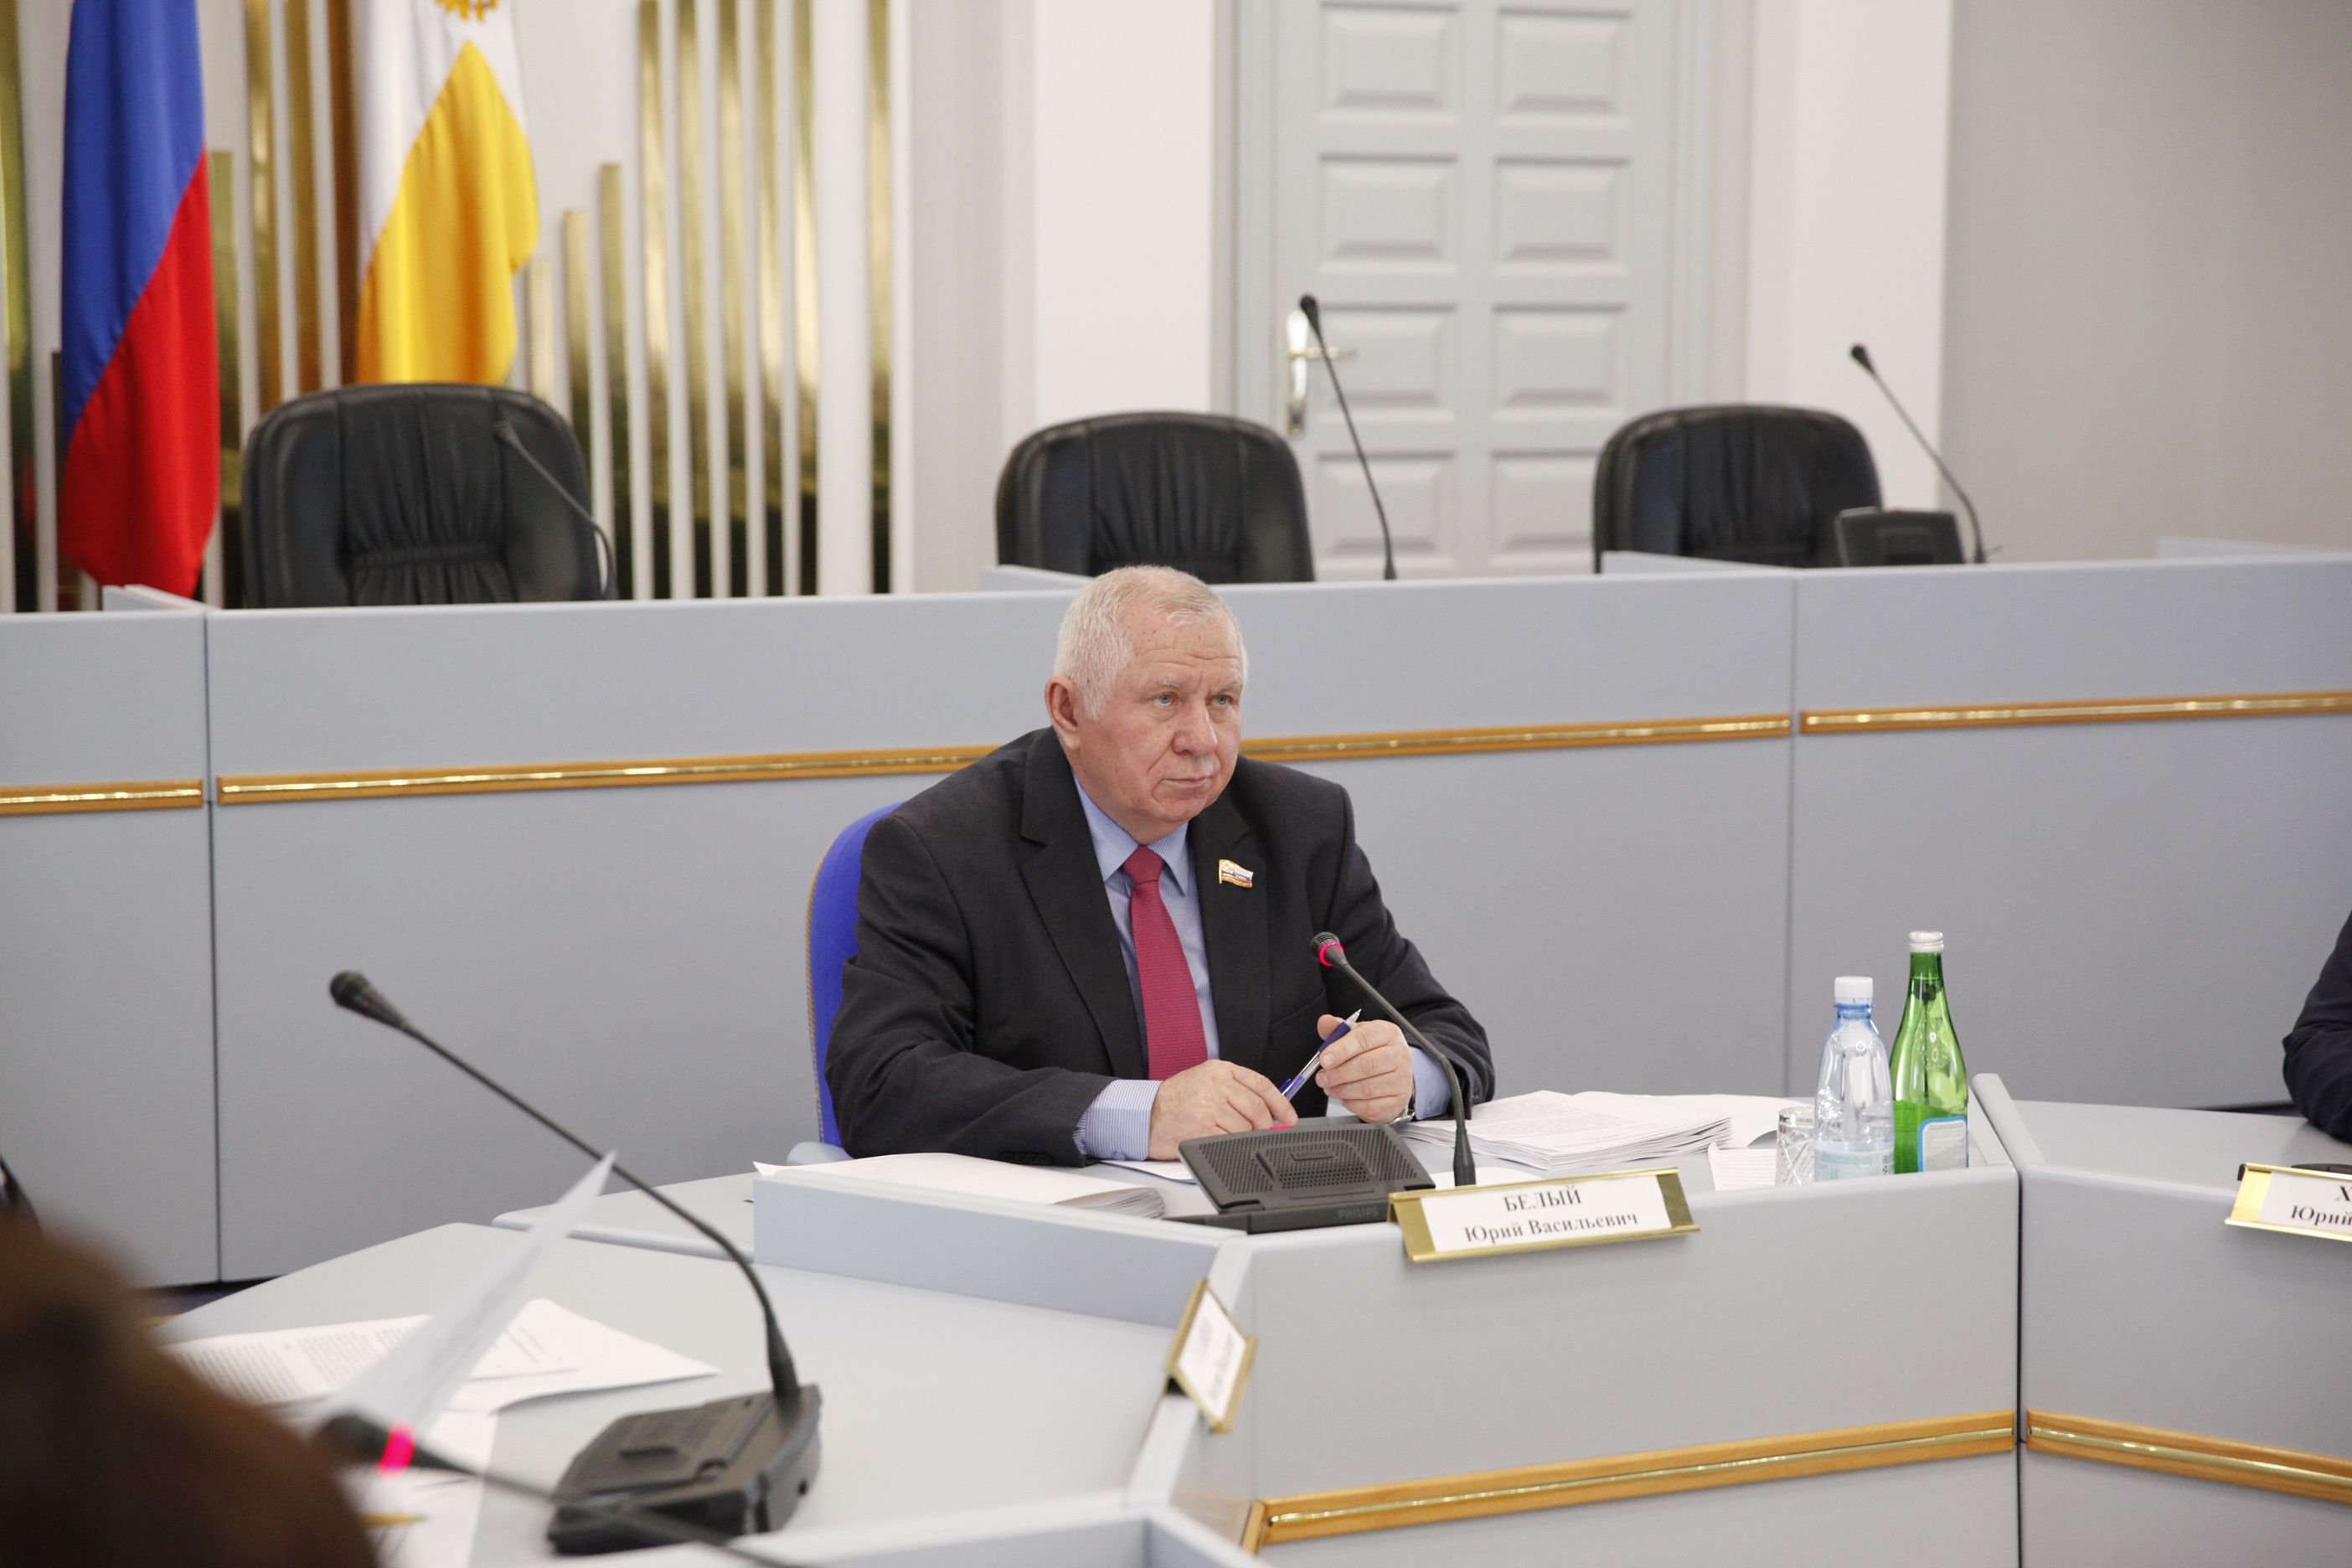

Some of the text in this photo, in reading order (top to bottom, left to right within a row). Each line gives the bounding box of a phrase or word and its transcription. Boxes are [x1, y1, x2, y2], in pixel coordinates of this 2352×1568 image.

[1504, 1184, 1582, 1212] БЕЛЫЙ
[1465, 1213, 1638, 1244] Юрий Васильевич
[2291, 1204, 2352, 1226] Юрий
